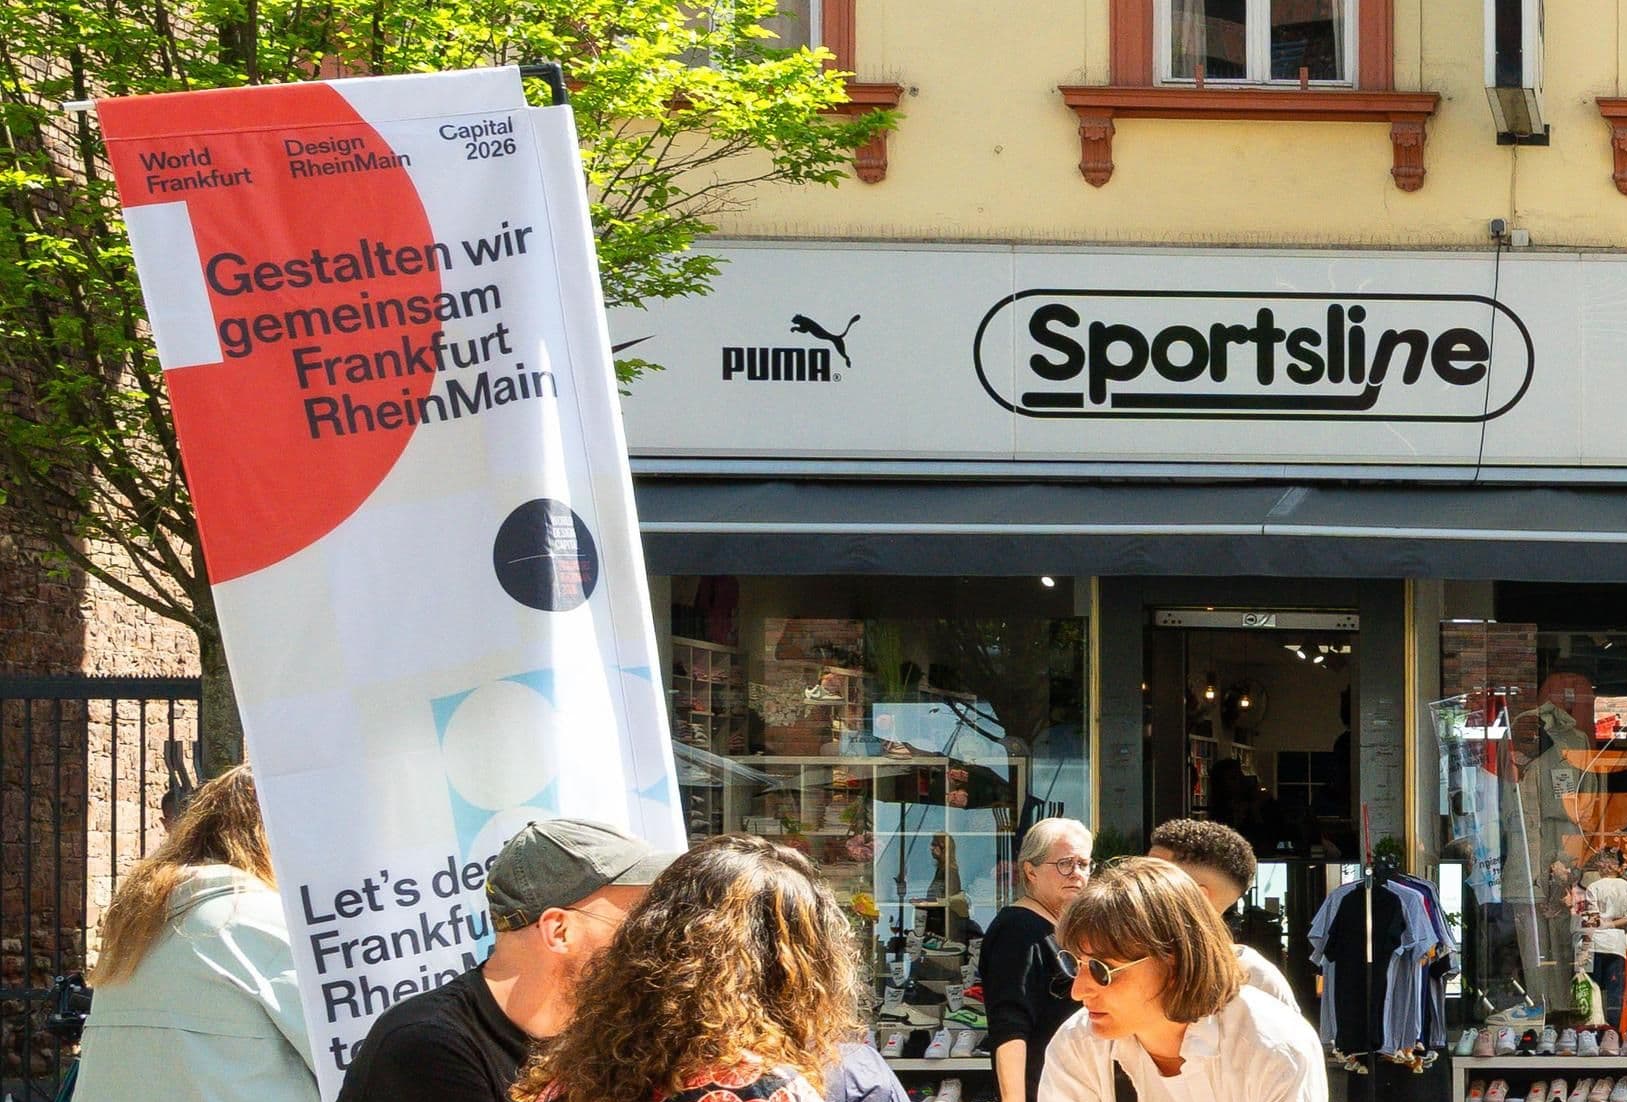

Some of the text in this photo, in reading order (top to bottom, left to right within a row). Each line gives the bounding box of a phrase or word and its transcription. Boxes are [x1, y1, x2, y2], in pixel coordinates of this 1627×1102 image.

[140, 116, 514, 172] World Design Capital
[146, 138, 517, 194] Frankfurt RheinMain 2026
[206, 221, 532, 298] Gestalten wir
[219, 284, 501, 359] gemeinsam
[293, 322, 512, 389] Frankfurt
[1029, 303, 1490, 405] Sportsline
[722, 347, 831, 382] PUMA
[304, 362, 558, 440] RheinMain
[310, 904, 489, 974] Frankfu
